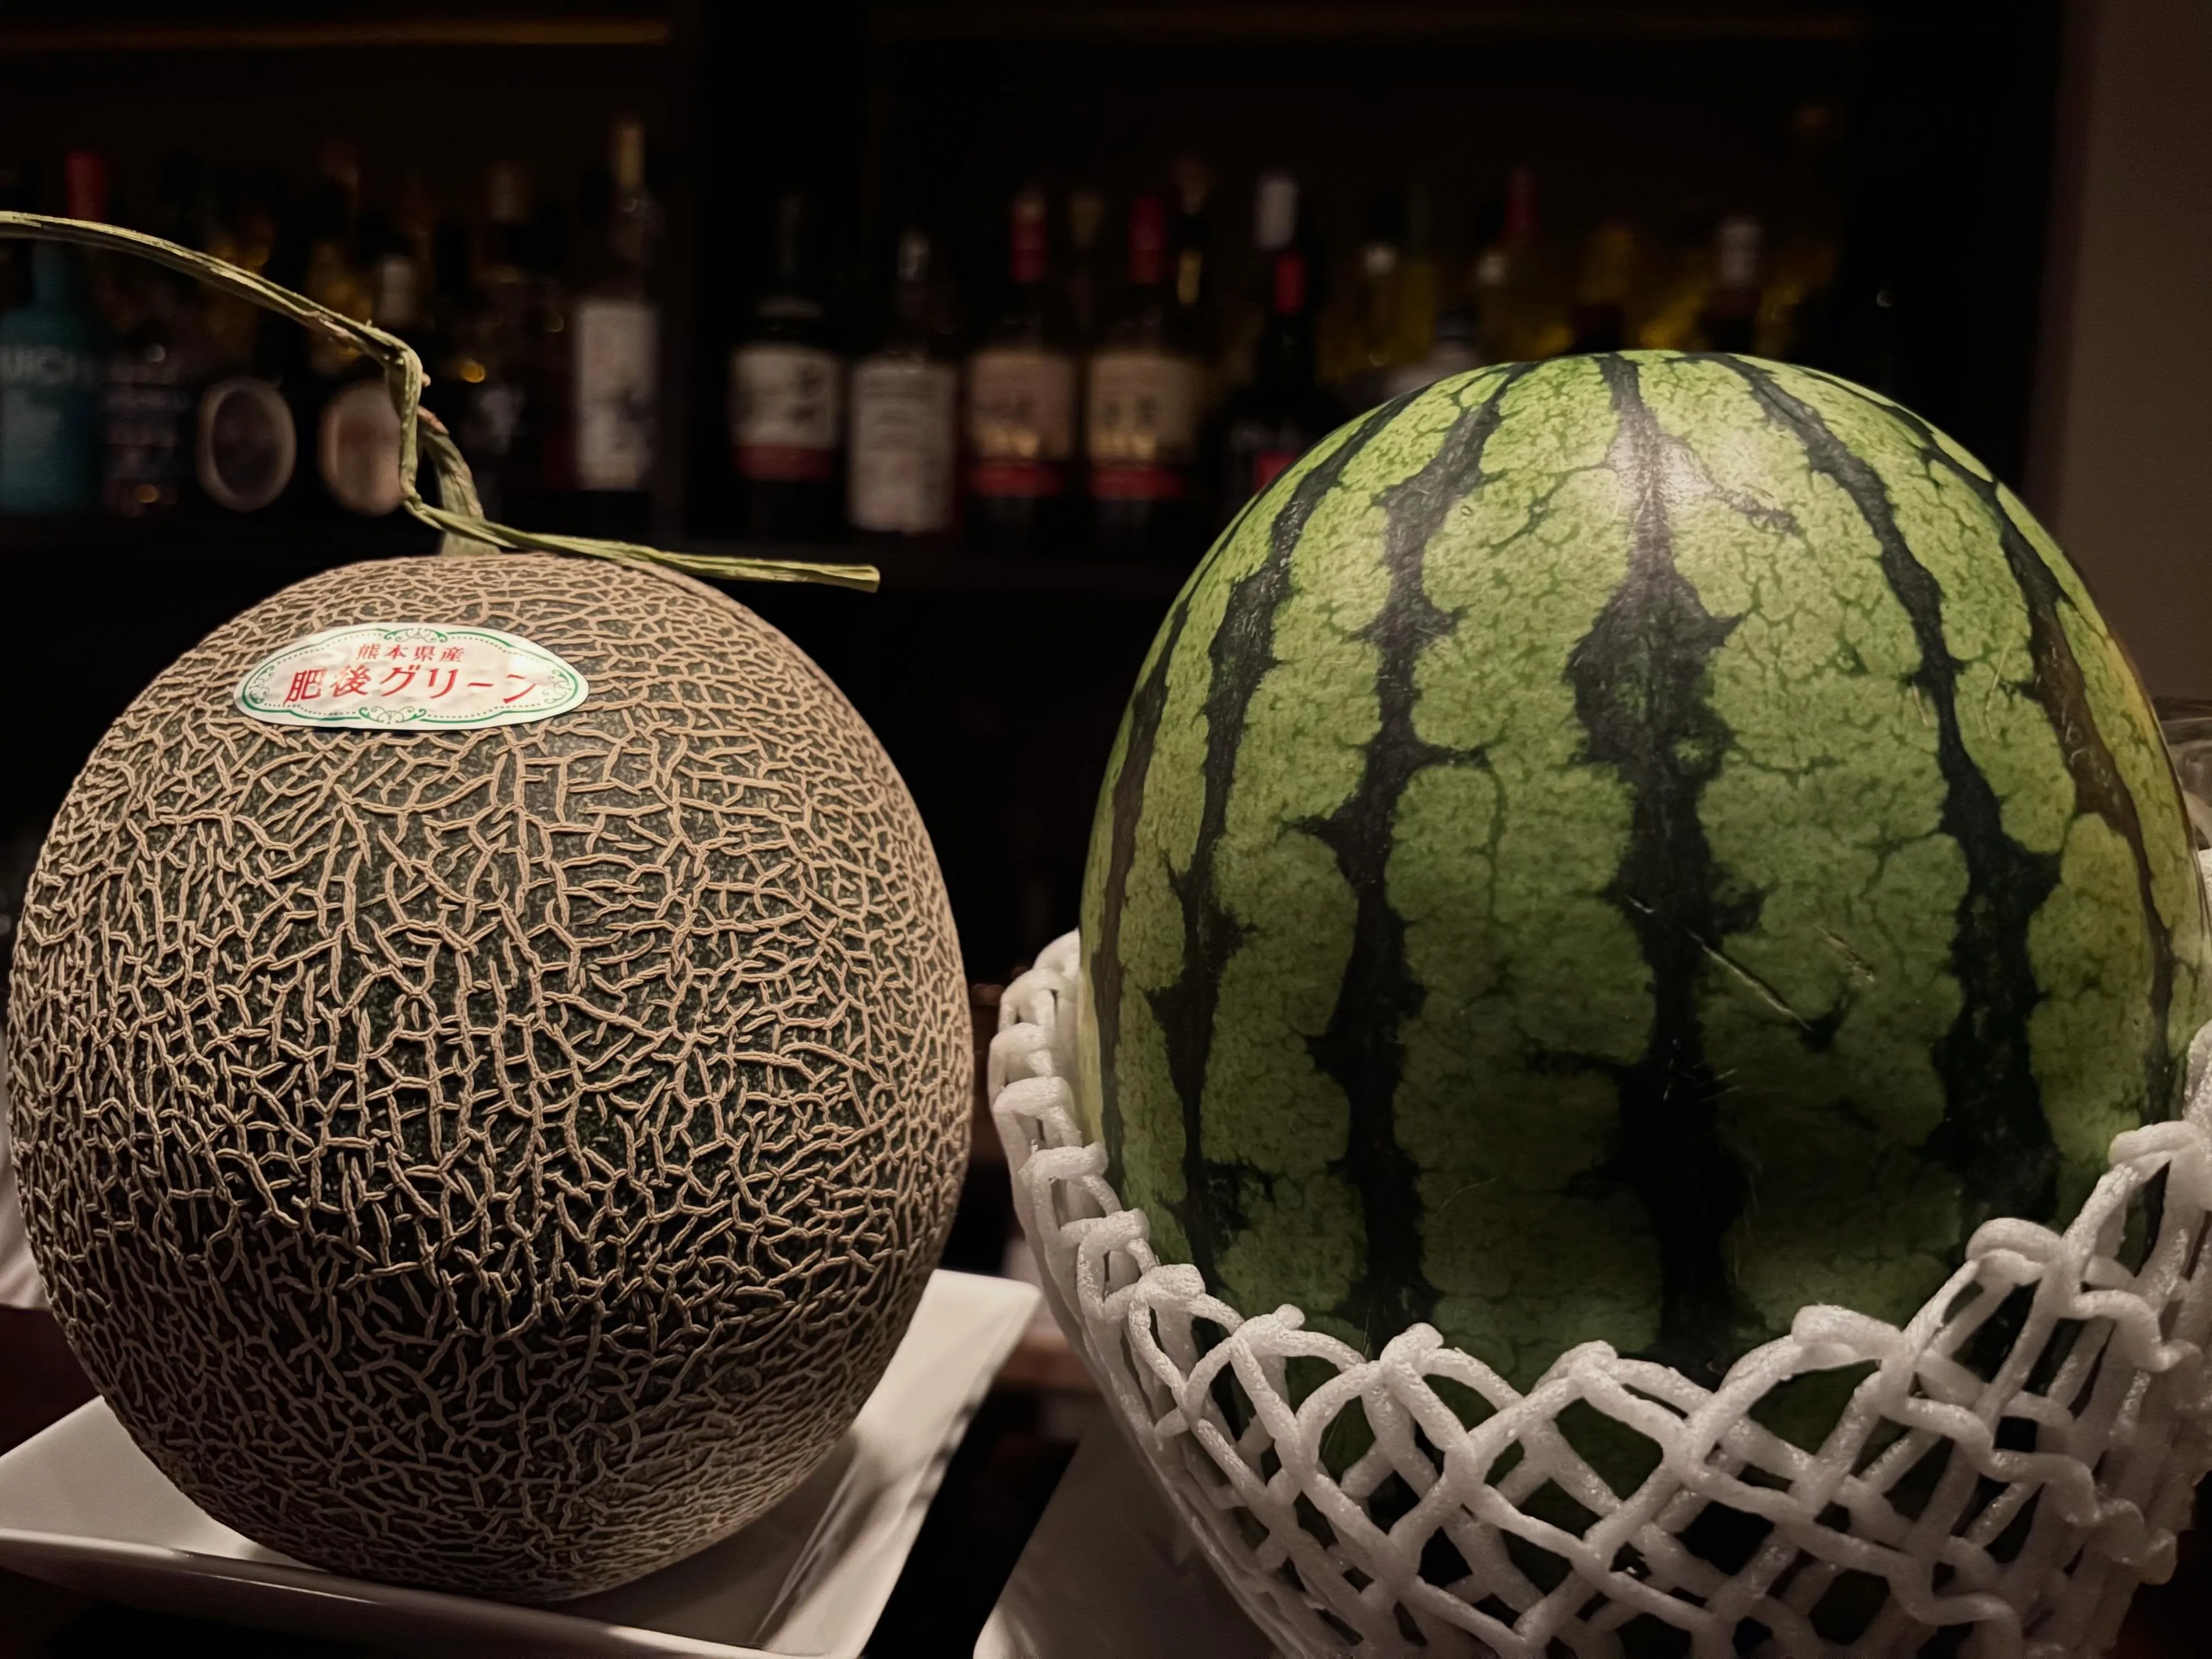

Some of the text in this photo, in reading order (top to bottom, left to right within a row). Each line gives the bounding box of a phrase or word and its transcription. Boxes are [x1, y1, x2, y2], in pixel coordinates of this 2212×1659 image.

[357, 644, 465, 662] 熊本県産
[283, 664, 538, 704] 肥後グリーン
